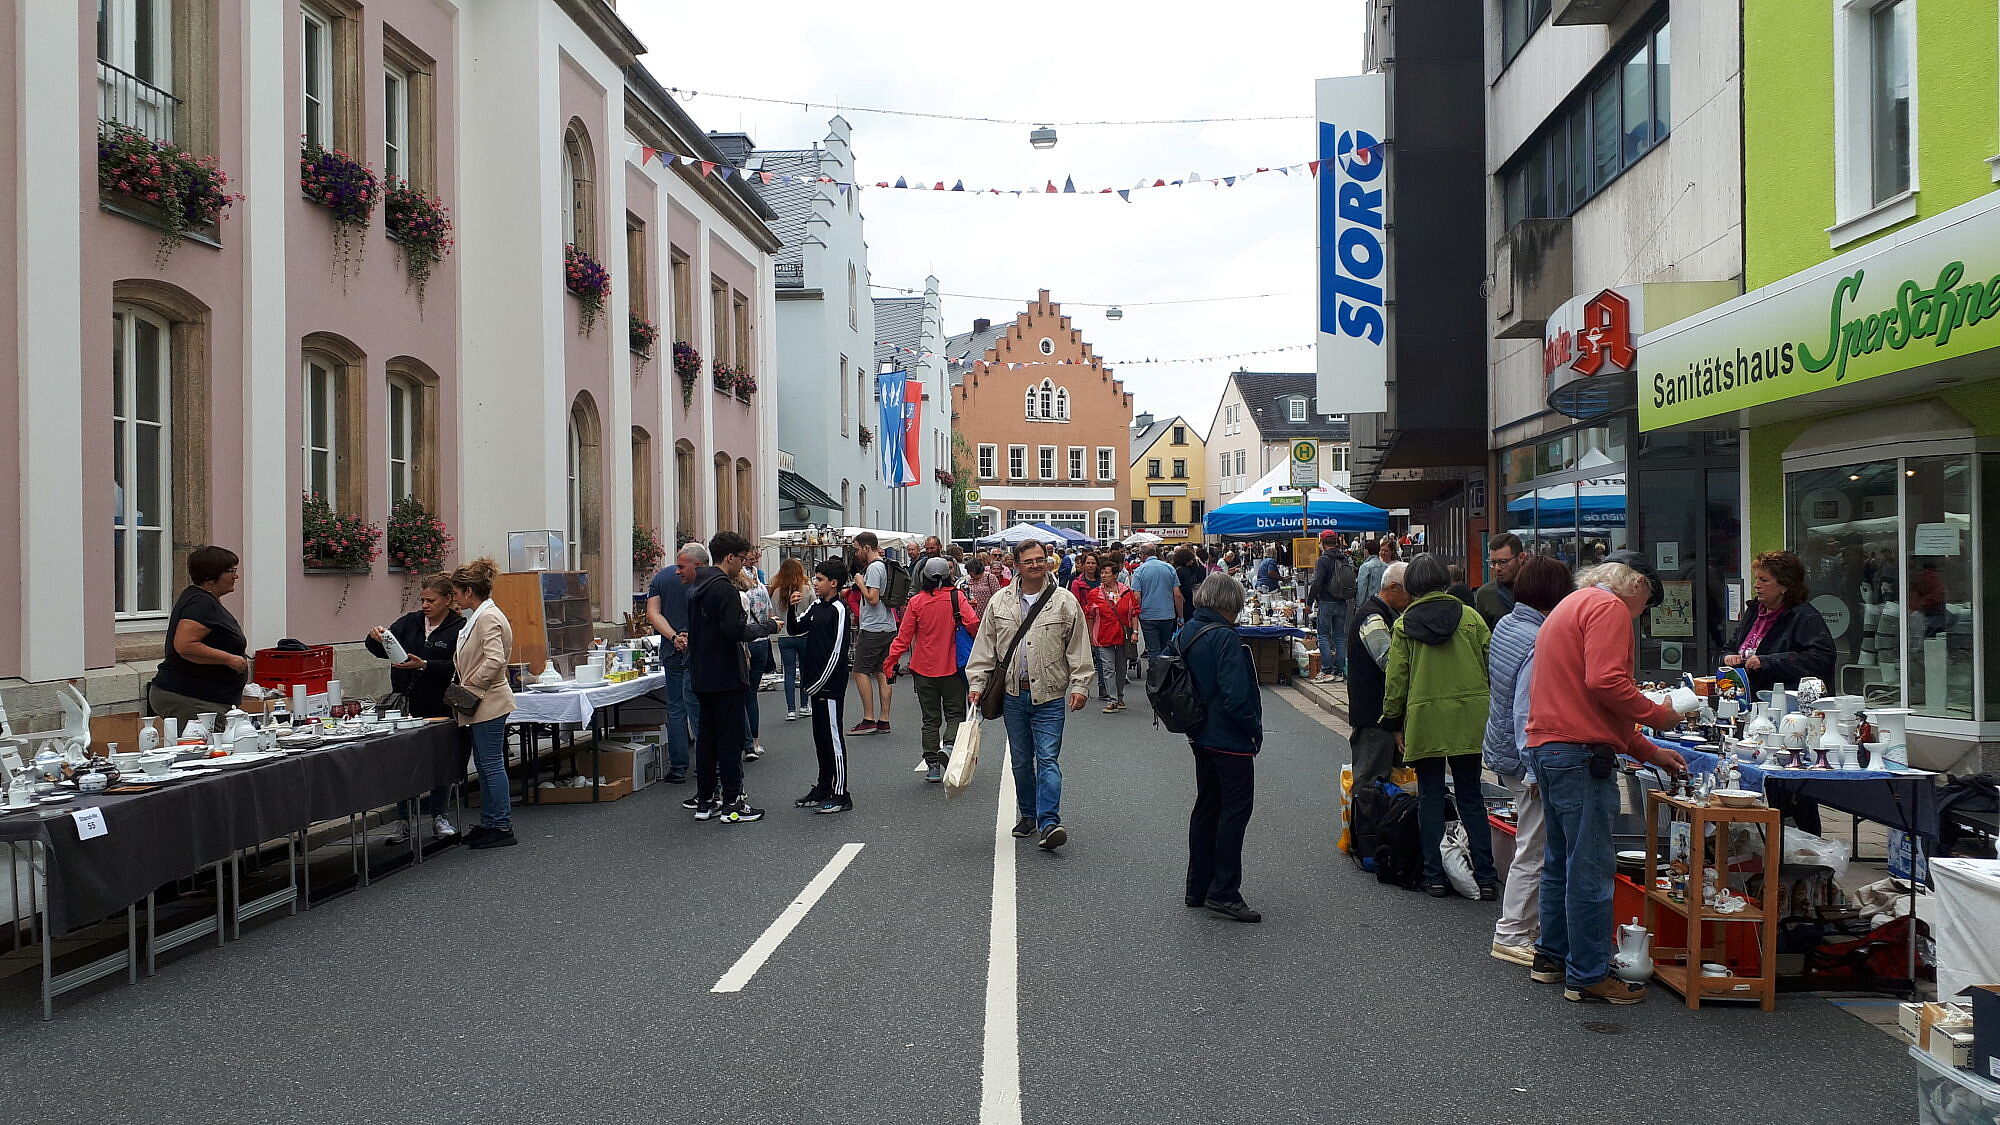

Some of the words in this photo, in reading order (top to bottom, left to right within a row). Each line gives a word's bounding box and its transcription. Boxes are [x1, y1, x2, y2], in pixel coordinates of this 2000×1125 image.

[1320, 121, 1384, 346] STORG
[1653, 341, 1794, 409] Sanitätshaus
[1256, 516, 1338, 528] btv-turnen.de
[88, 822, 96, 830] 55
